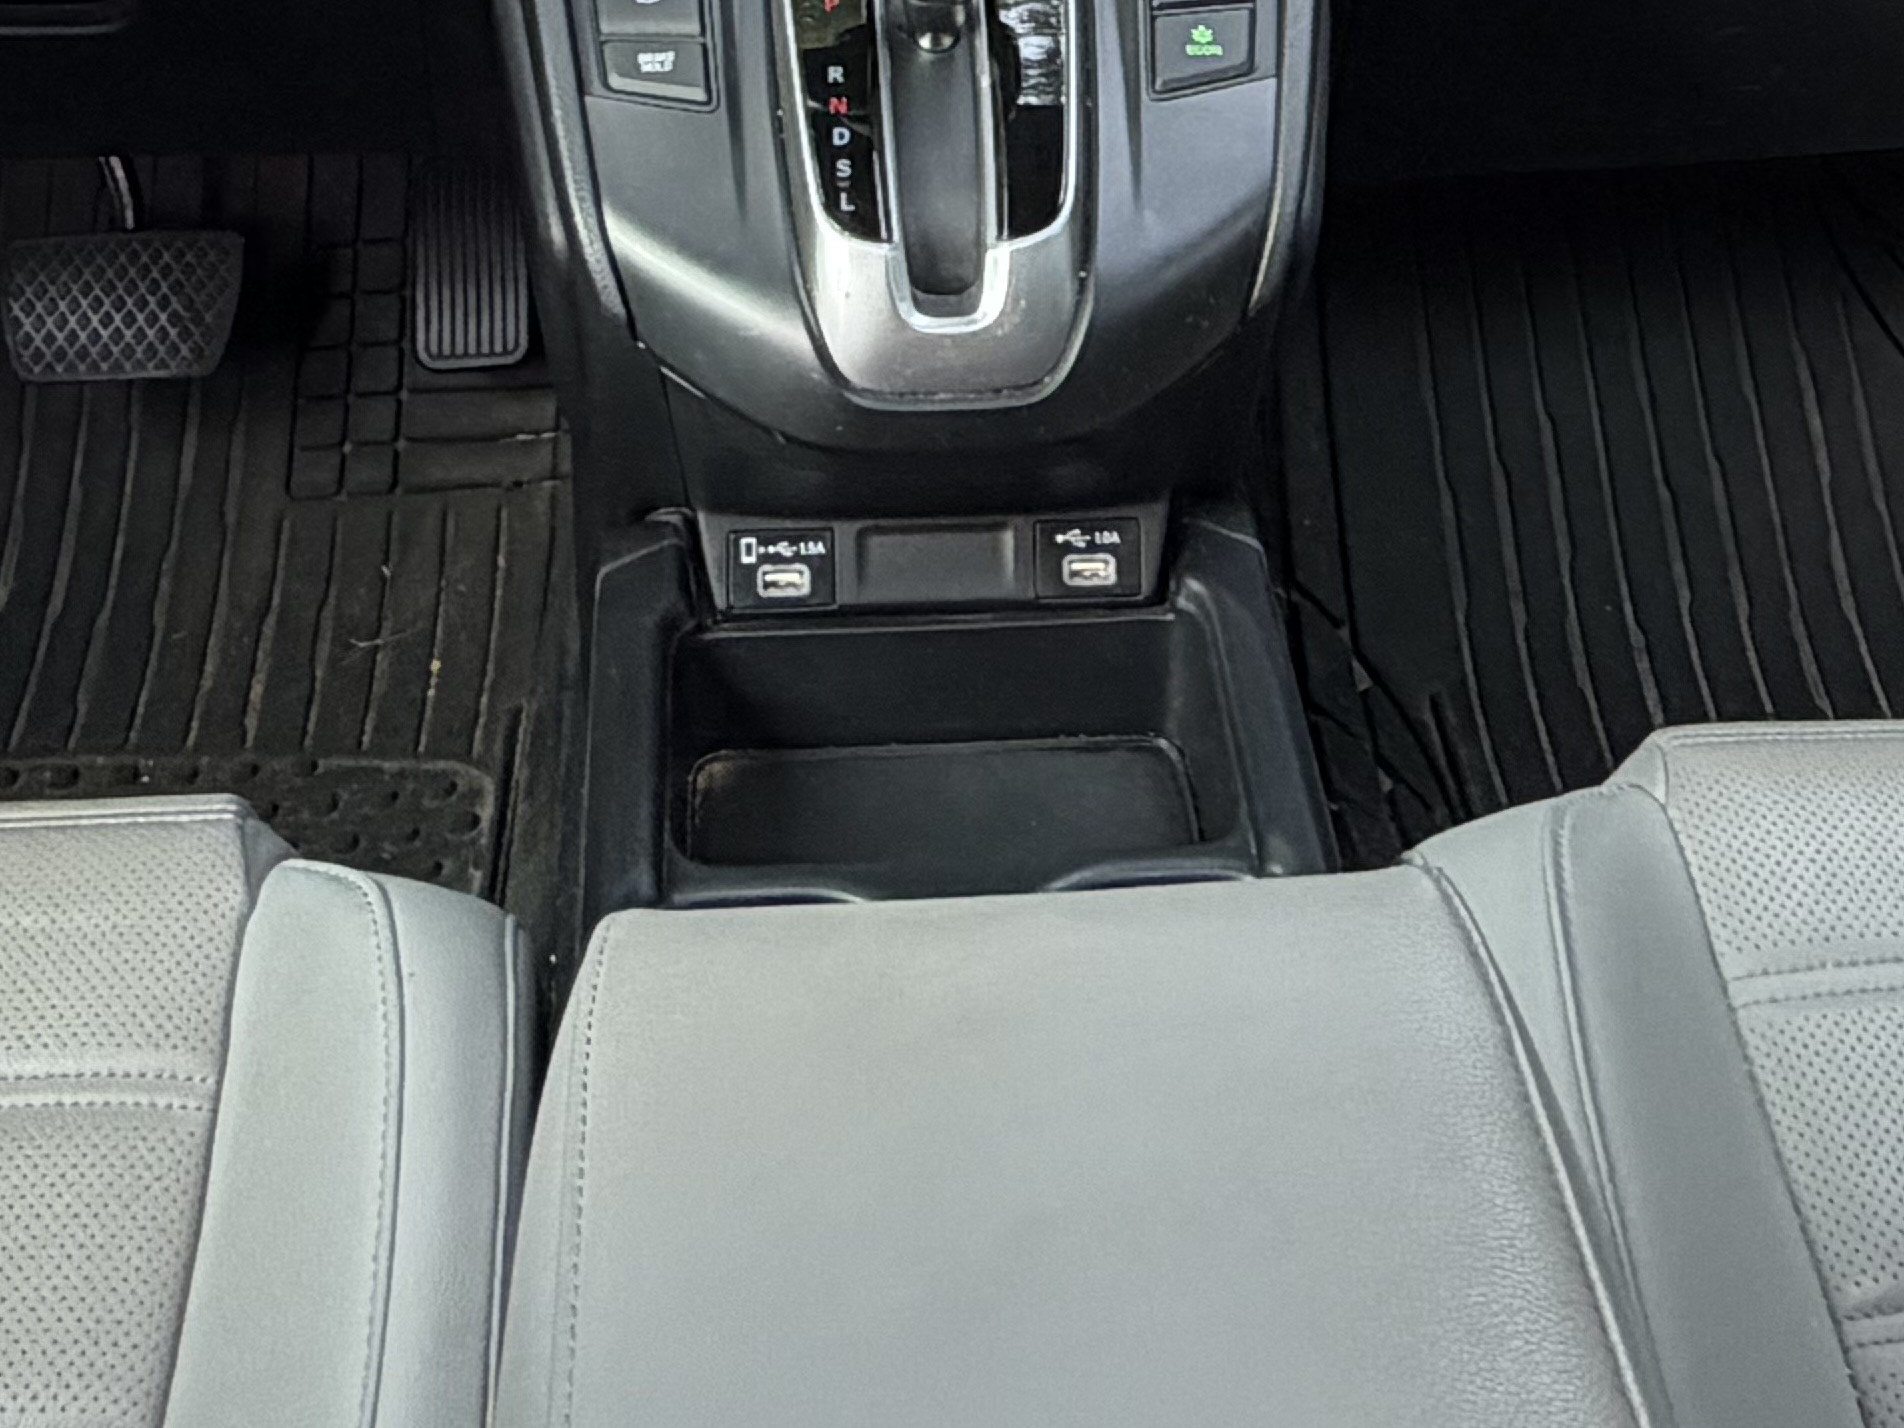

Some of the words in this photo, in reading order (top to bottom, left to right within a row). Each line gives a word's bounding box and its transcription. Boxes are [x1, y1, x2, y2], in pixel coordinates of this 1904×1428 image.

[826, 65, 845, 84] R
[828, 96, 849, 115] N
[832, 127, 851, 146] D
[835, 158, 852, 178] S
[840, 192, 856, 212] L
